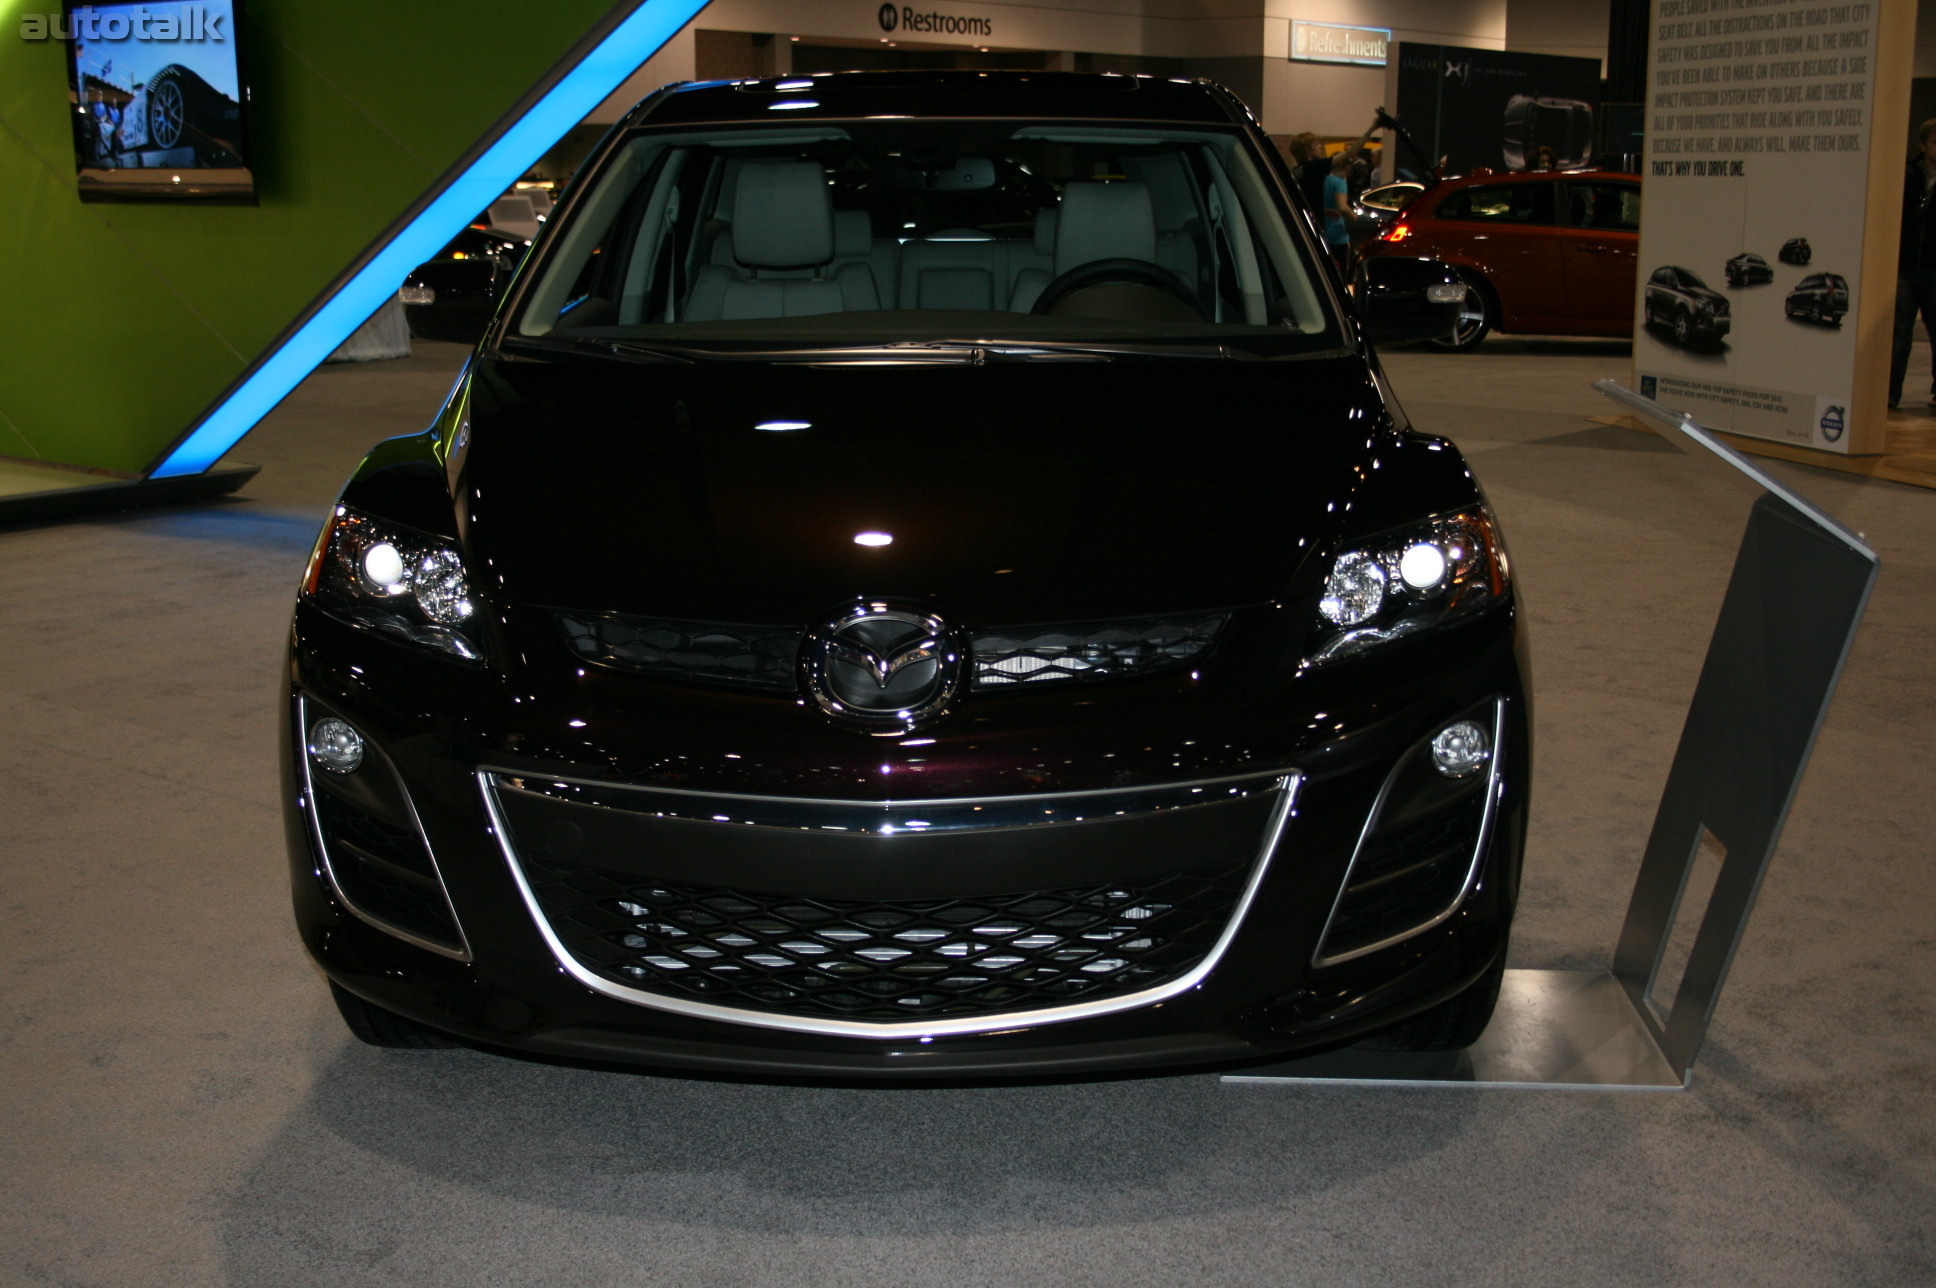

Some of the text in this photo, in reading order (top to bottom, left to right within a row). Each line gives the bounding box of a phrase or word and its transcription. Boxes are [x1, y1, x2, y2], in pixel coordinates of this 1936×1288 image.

[903, 7, 992, 36] Restrooms
[1659, 24, 1675, 40] SEAT
[1695, 20, 1707, 37] ALL
[1709, 19, 1722, 36] THE
[1723, 14, 1775, 34] DISTRACTIONS
[1776, 12, 1787, 30] ON
[1789, 10, 1803, 28] THE
[1805, 8, 1827, 27] ROAD
[1829, 6, 1850, 24] THAT
[1852, 3, 1871, 22] CITY
[1660, 2, 1684, 18] PEOPLE
[1686, 0, 1707, 15] SAVED
[1310, 31, 1387, 58] Refreshments
[1657, 47, 1681, 64] SAFETY
[1683, 45, 1699, 61] WAS
[1700, 42, 1733, 59] DESIGNED
[1734, 41, 1744, 57] TO
[1745, 40, 1762, 57] SAVE
[1764, 38, 1780, 55] YOU
[1806, 34, 1820, 52] ALL
[1822, 33, 1837, 51] THE
[1839, 30, 1869, 49] IMPACT
[1682, 67, 1700, 85] BEEN
[1702, 66, 1720, 83] ABLE
[1722, 65, 1732, 82] TO
[1733, 64, 1754, 81] MAKE
[1756, 63, 1768, 80] ON
[1769, 61, 1800, 79] OTHERS
[1802, 58, 1839, 77] BECAUSE
[1840, 57, 1848, 75] A
[1849, 56, 1867, 74] SIDE
[1655, 92, 1679, 109] IMPACT
[1680, 90, 1719, 108] PROTECTION
[1720, 89, 1746, 106] SYSTEM
[1747, 87, 1765, 104] KEPT
[1767, 86, 1783, 104] YOU
[1805, 84, 1822, 102] AND
[1824, 83, 1848, 101] THERE
[1849, 81, 1866, 100] ARE
[1654, 115, 1665, 131] ALL
[1666, 114, 1675, 130] OF
[1676, 114, 1694, 130] YOUR
[1695, 112, 1730, 130] PRIORITIES
[1732, 112, 1749, 129] THAT
[1750, 111, 1767, 128] RIDE
[1769, 110, 1793, 128] ALONG
[1795, 109, 1815, 128] WITH
[1817, 109, 1833, 127] YOU
[1652, 138, 1682, 154] BECAUSE
[1683, 138, 1695, 153] WE
[1717, 137, 1733, 153] AND
[1734, 136, 1764, 153] ALWAYS
[1789, 135, 1811, 152] MAKE
[1813, 134, 1836, 152] THEM
[1652, 161, 1745, 176] THAT'S WHY YOU DRIVE ONE.
